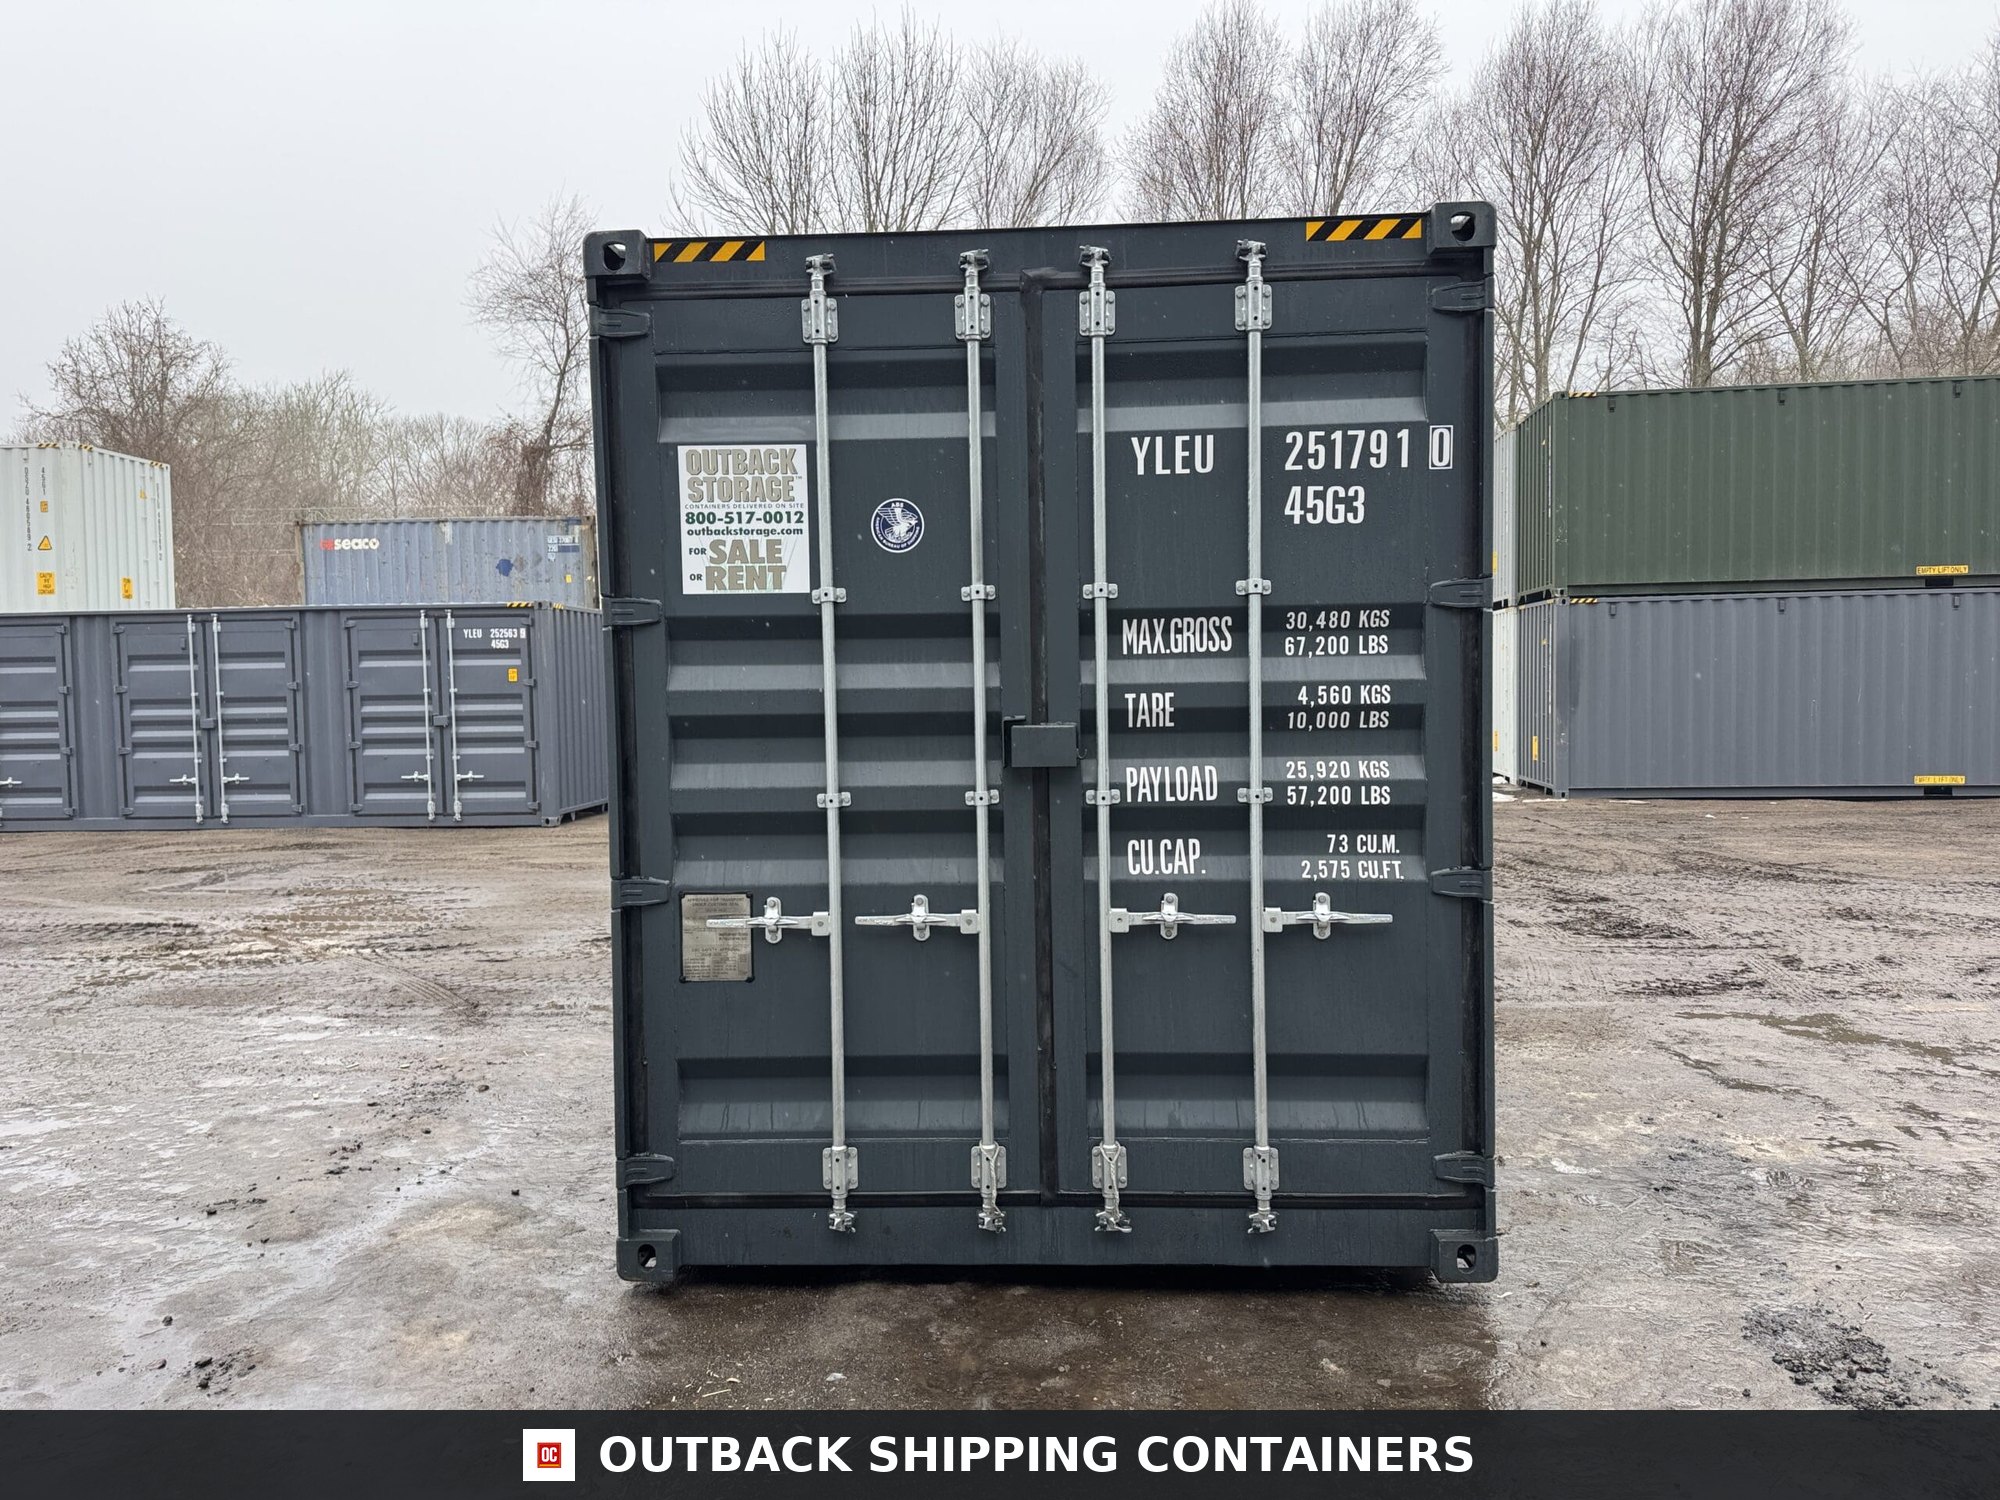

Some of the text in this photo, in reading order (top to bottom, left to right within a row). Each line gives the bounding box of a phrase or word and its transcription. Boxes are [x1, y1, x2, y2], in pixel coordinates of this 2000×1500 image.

[685, 447, 798, 475] OUTBACK
[1130, 426, 1451, 476] YLEU 251791 0
[687, 475, 795, 503] STORAGE
[1284, 485, 1365, 525] 45G3
[685, 511, 804, 524] 800-517-0012
[686, 526, 804, 537] outbackstorage.com
[688, 539, 783, 565] FOR SALE
[689, 565, 787, 591] OR RENT
[1285, 609, 1391, 632] 30,480 KGS
[463, 628, 483, 639] YLEU
[1122, 616, 1233, 655] MAX.GROSS
[1284, 635, 1389, 659] 67,200 LBS
[1297, 684, 1392, 707] 4,560 KGS
[1124, 691, 1175, 728] TARE
[1287, 710, 1390, 732] 10,000 LBS
[1285, 760, 1390, 782] 25,920 KGS
[1126, 765, 1218, 803] PAYLOAD
[1287, 785, 1391, 807] 57,200 LBS
[1327, 834, 1400, 854] 73 CU.M.
[1127, 838, 1206, 876] CU.CAP.
[1301, 860, 1405, 881] 2,575 CU.FT.
